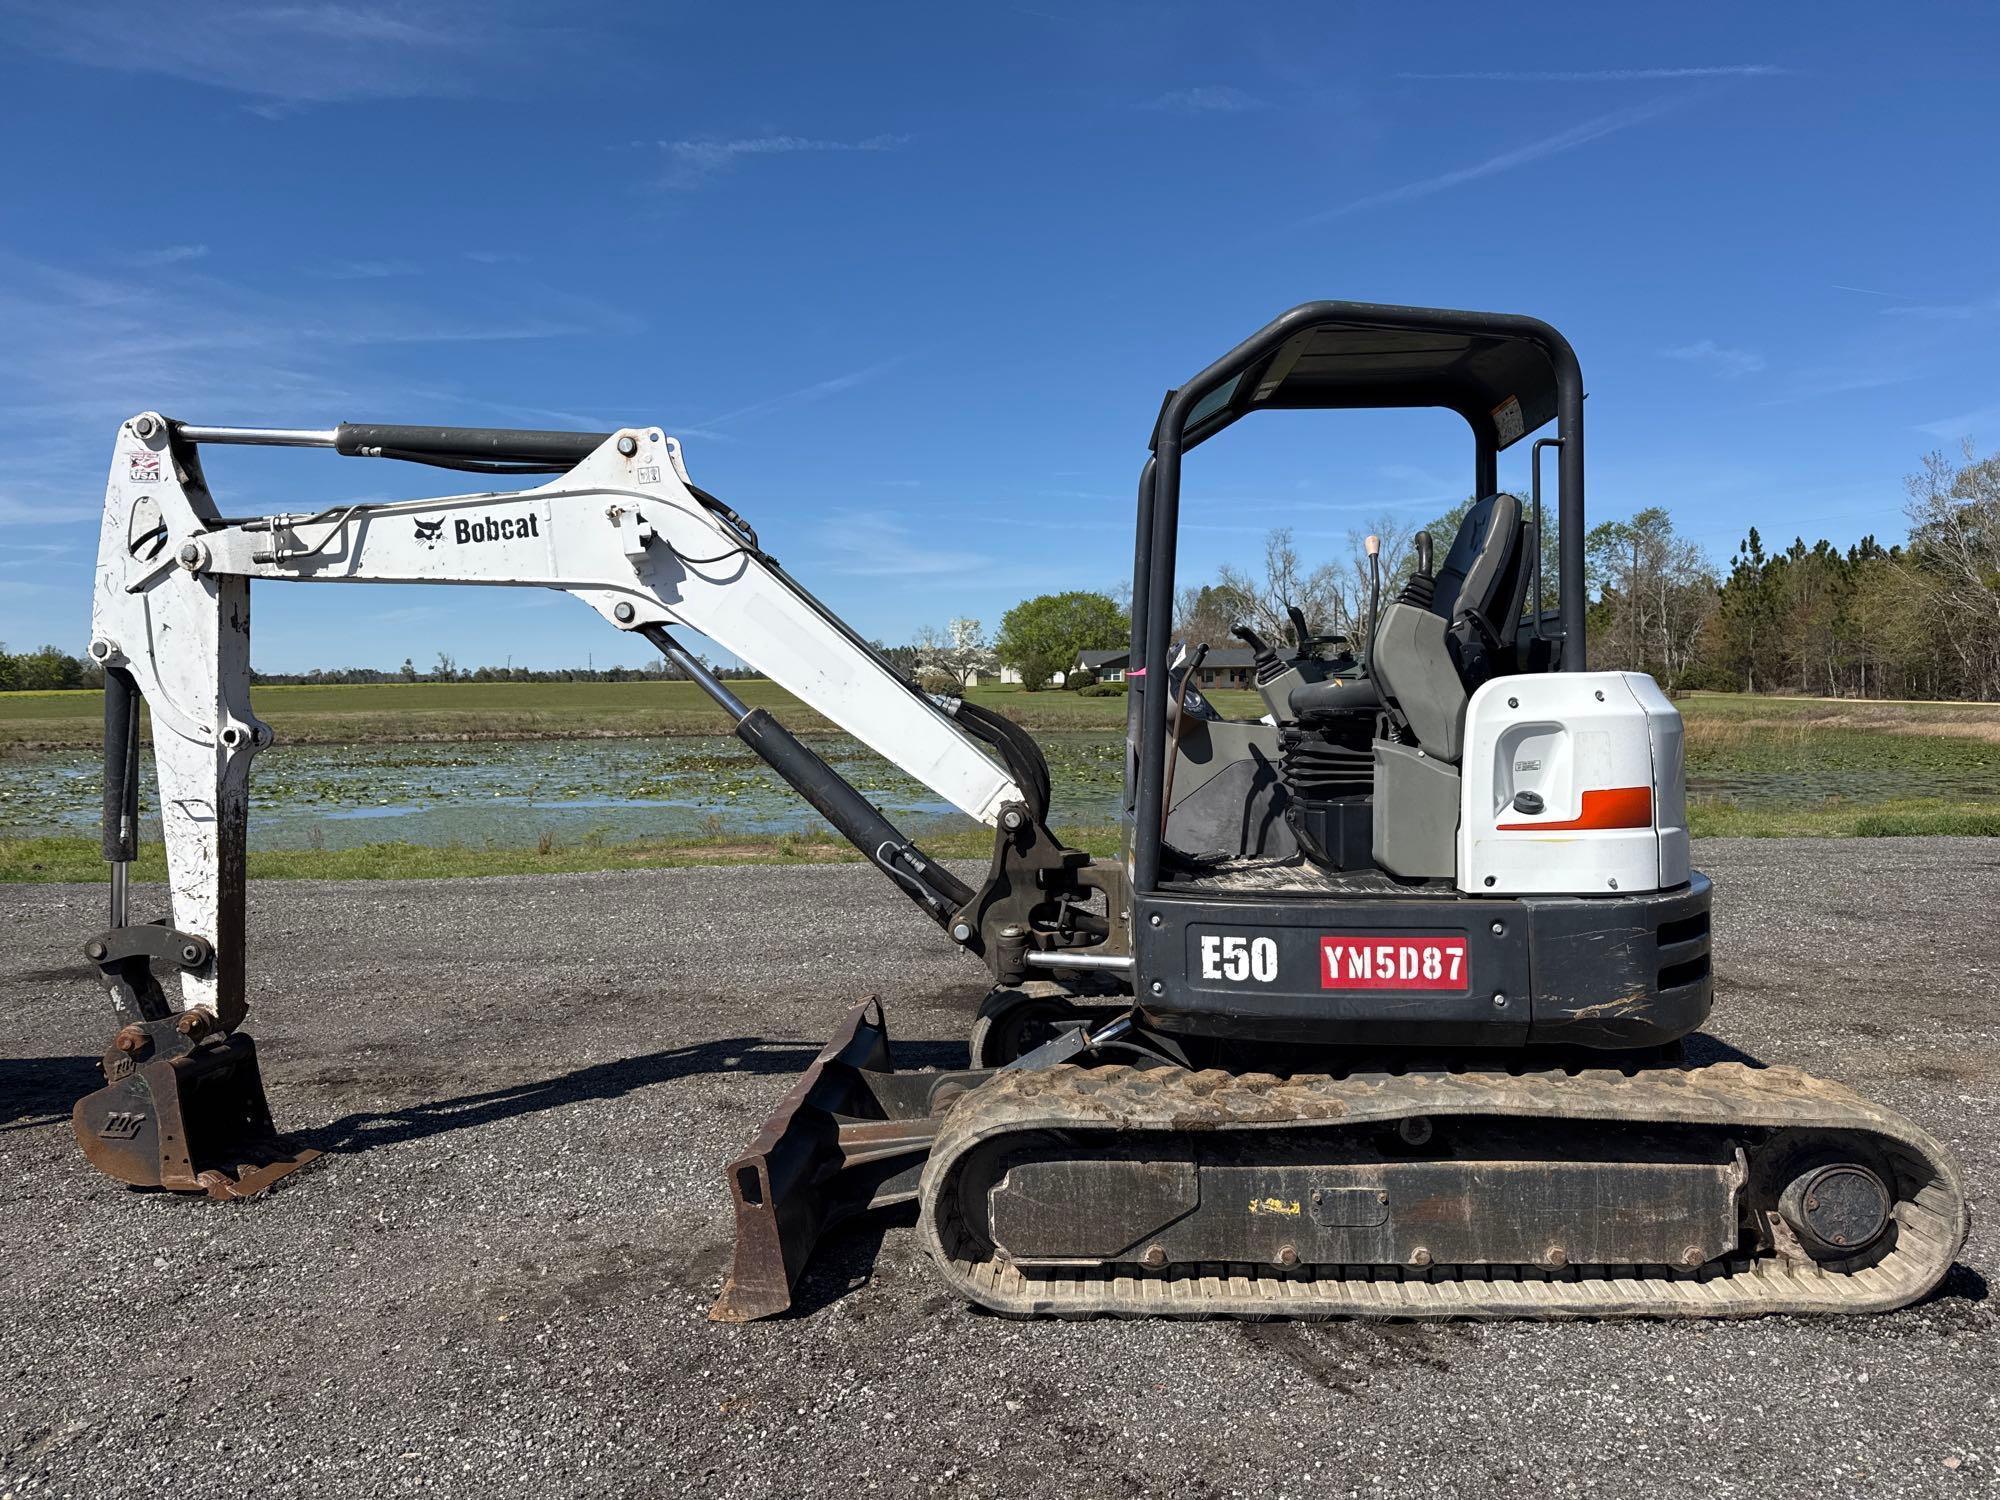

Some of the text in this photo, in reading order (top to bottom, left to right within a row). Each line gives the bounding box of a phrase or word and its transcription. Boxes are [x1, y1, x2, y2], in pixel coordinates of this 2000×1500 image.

[131, 472, 159, 480] USA
[454, 513, 539, 544] Bobcat
[1201, 936, 1278, 982] E50
[1324, 946, 1463, 980] YM5D87
